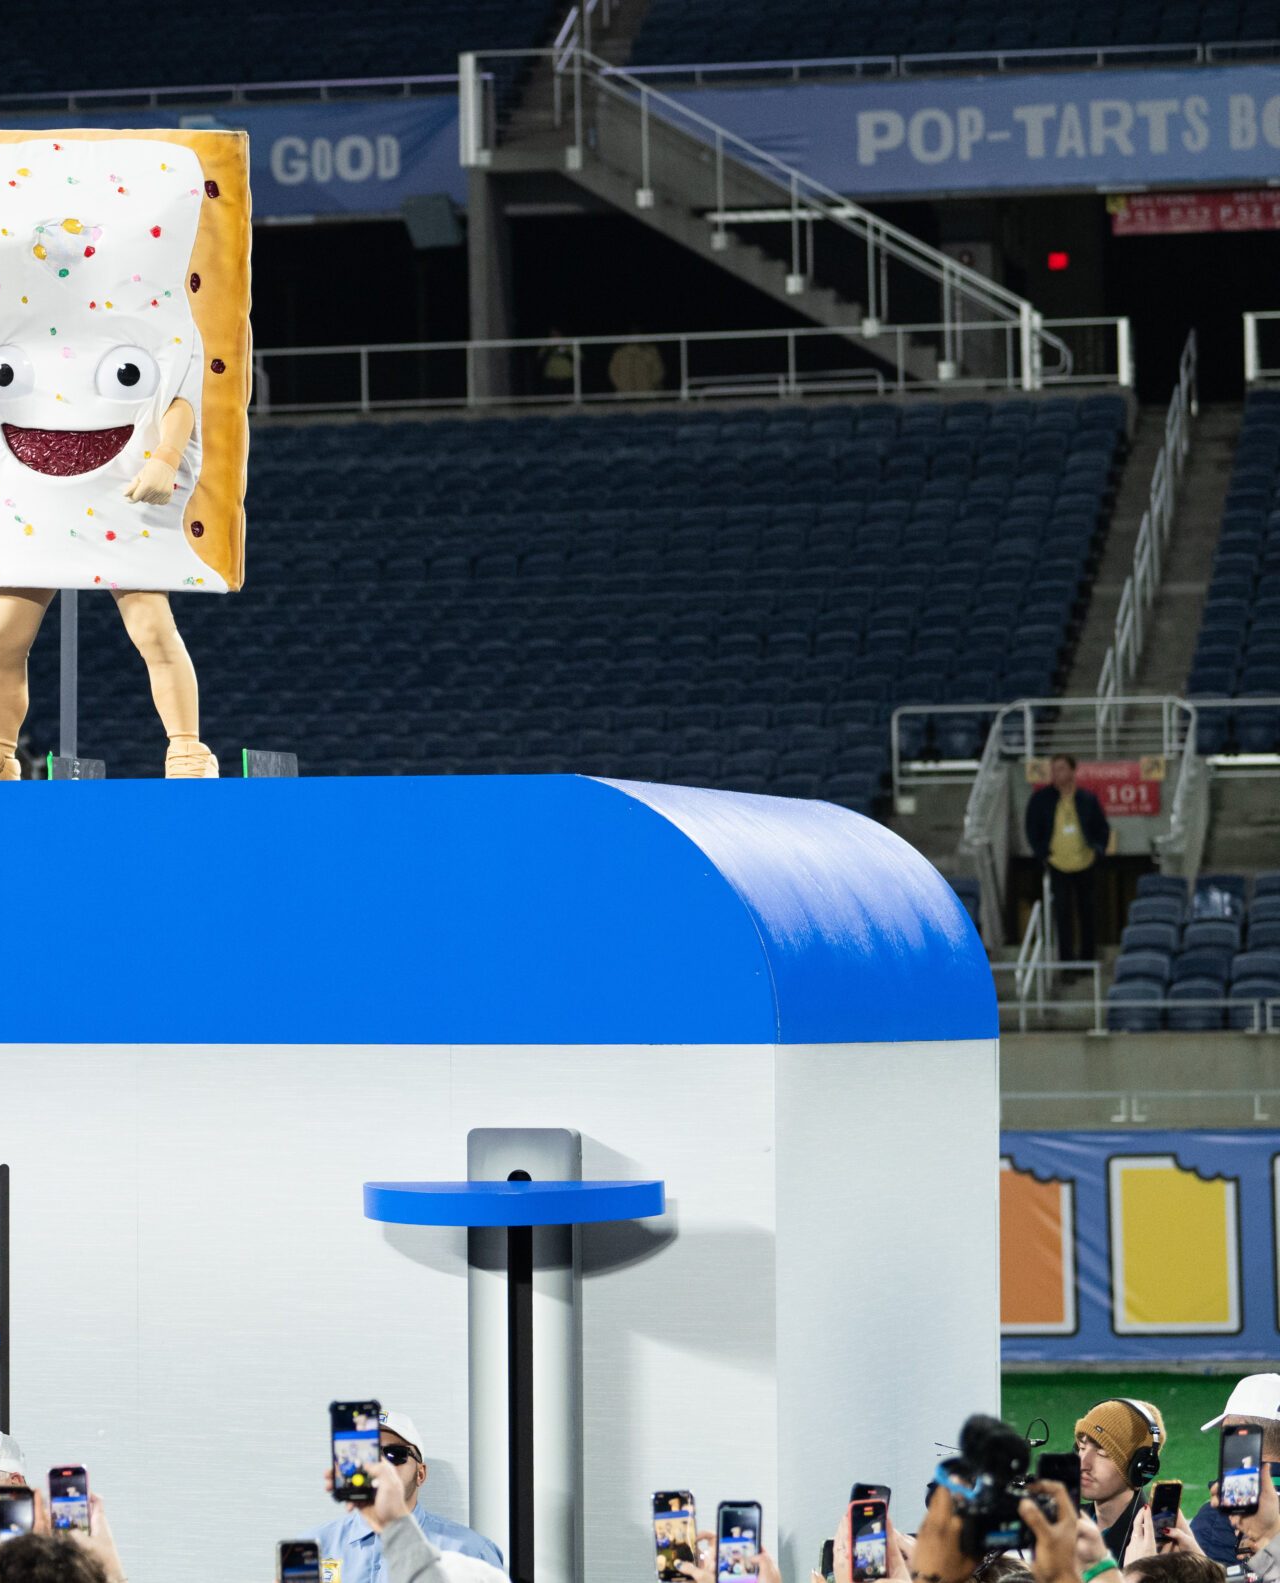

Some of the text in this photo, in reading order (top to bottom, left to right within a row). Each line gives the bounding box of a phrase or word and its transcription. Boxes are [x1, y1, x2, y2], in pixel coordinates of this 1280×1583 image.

[857, 95, 1210, 166] POP-TARTS
[271, 134, 401, 186] GOOD
[1107, 784, 1149, 804] 101
